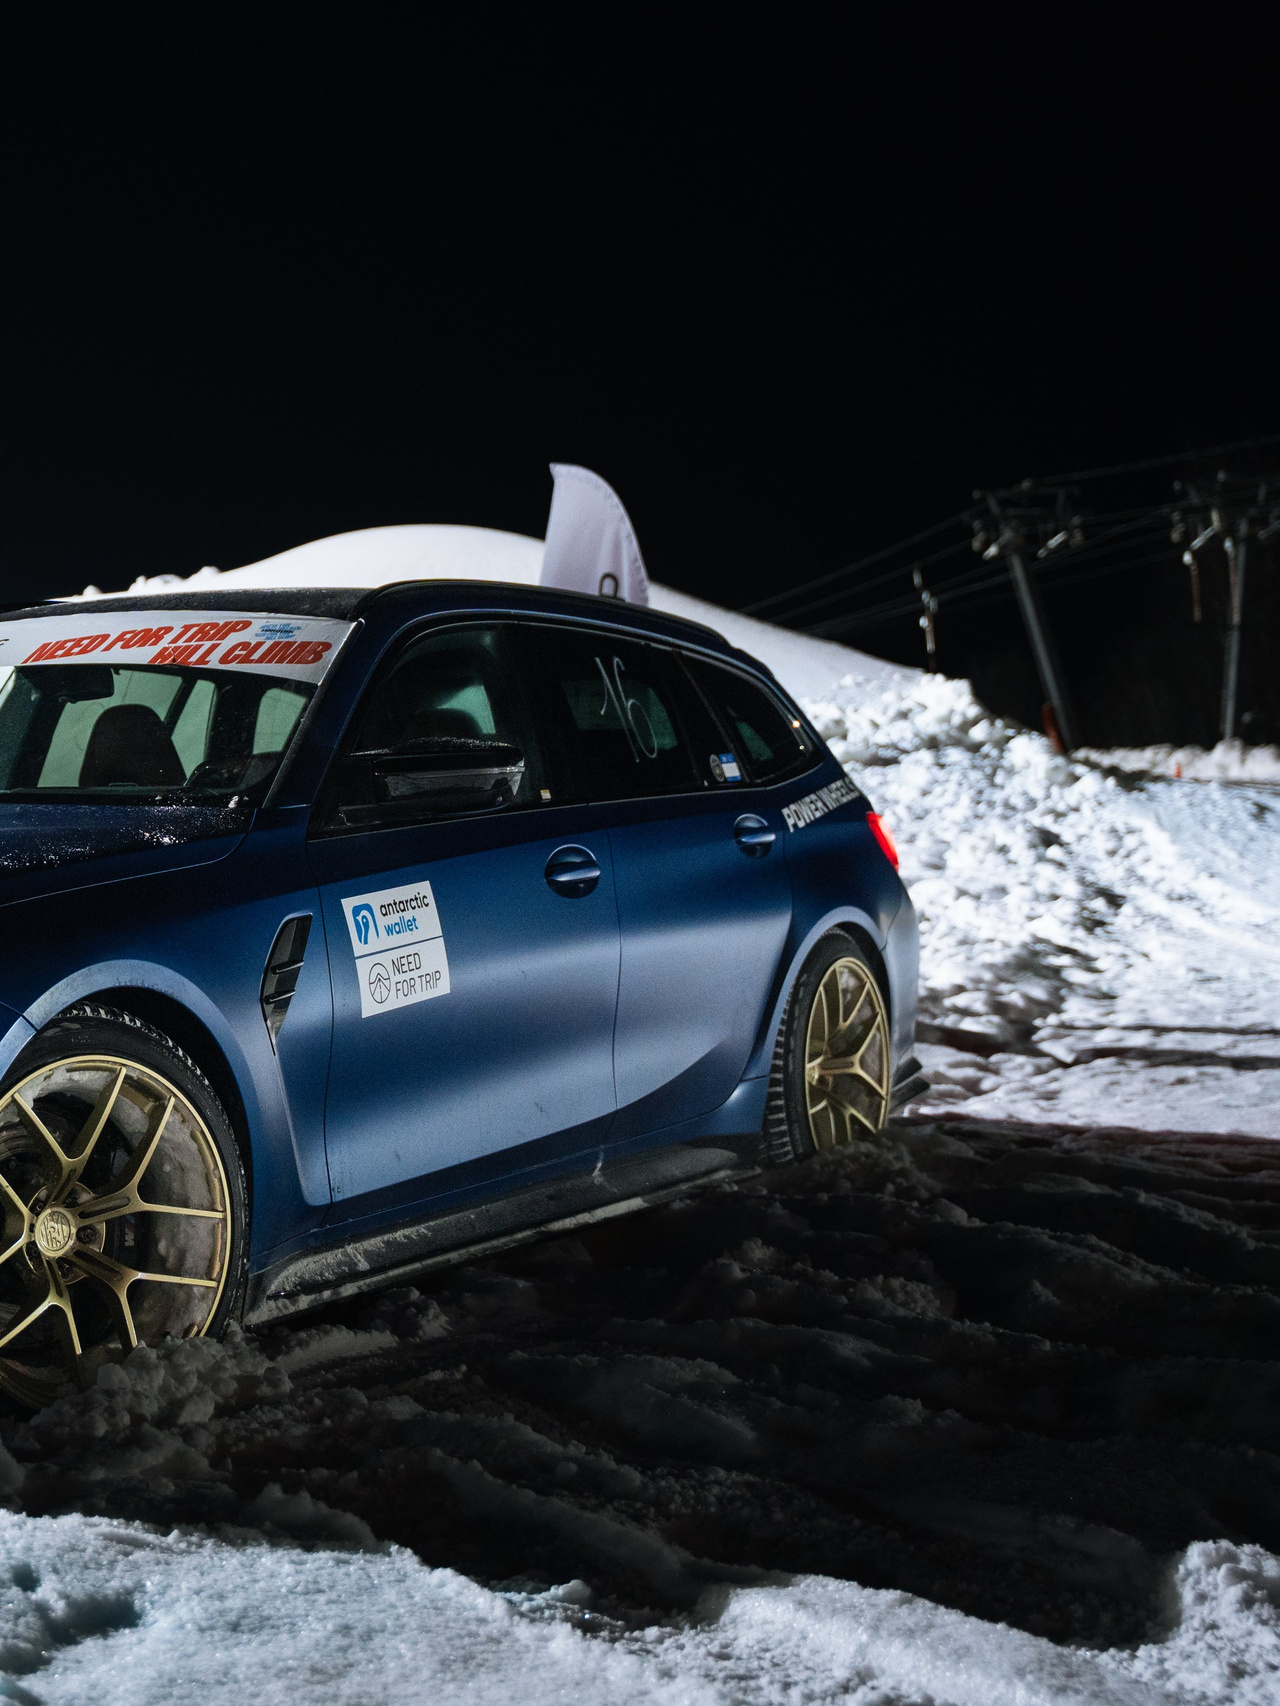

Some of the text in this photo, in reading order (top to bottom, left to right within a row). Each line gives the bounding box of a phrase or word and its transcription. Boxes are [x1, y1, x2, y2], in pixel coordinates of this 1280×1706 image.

[20, 620, 253, 664] NEED FOR TRIP
[147, 641, 332, 666] HILL CLIMB
[594, 656, 658, 763] 16
[379, 892, 430, 917] antarctic
[384, 915, 419, 937] wallet
[391, 952, 422, 976] NEED
[395, 970, 442, 1000] FOR TRIP
